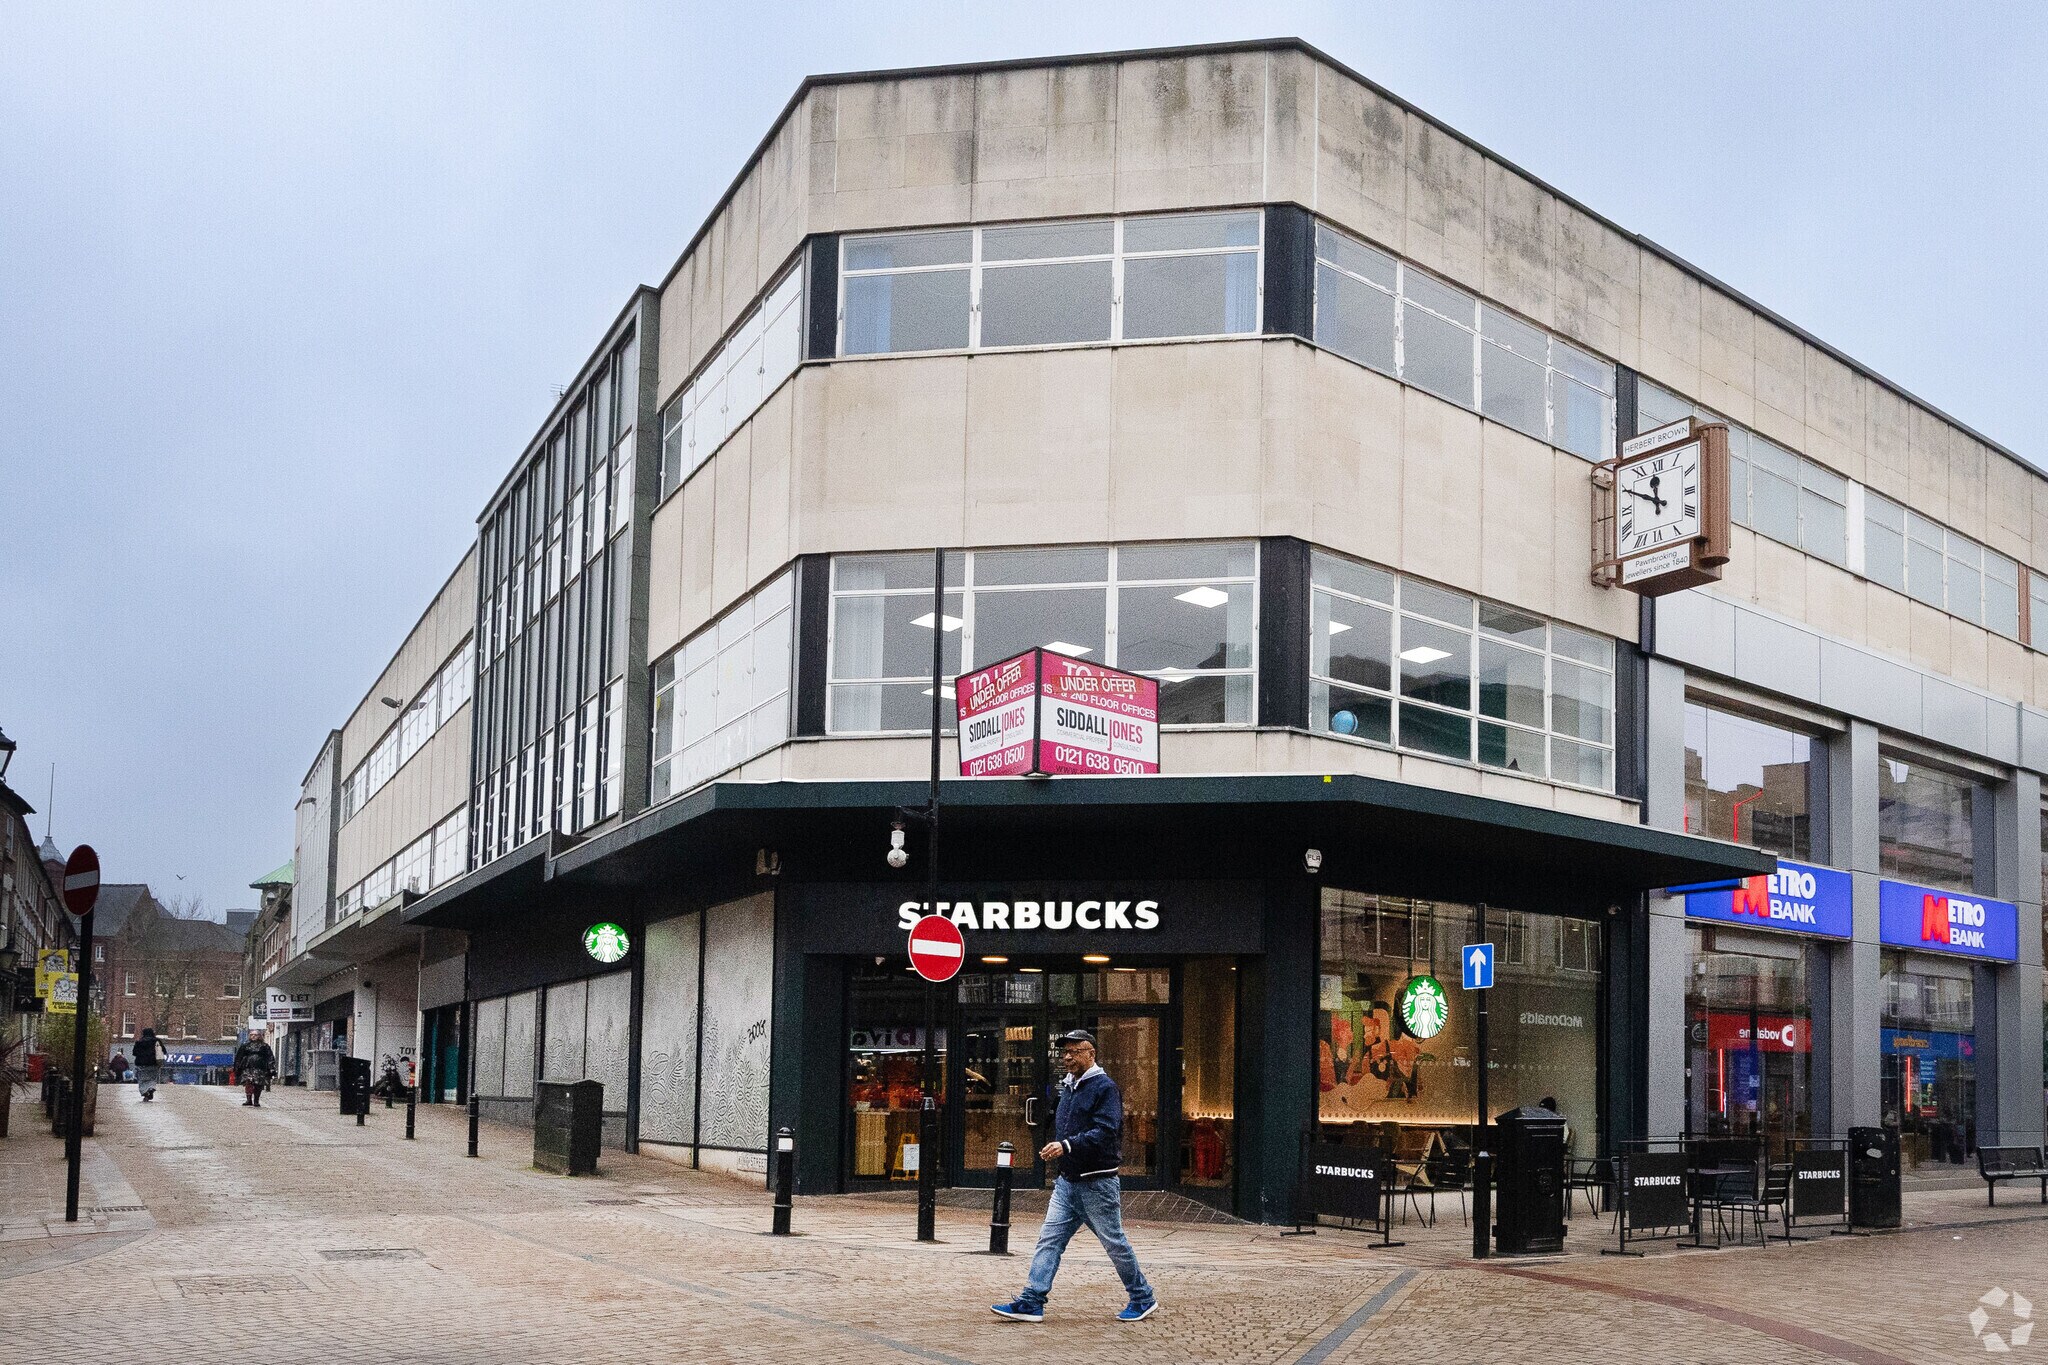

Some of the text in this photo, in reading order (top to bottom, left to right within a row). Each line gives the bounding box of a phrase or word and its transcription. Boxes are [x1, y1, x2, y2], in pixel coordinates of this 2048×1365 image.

[1625, 426, 1688, 453] HERBERT BROWN
[1636, 552, 1678, 567] Pawnbroking
[1654, 562, 1670, 571] since
[1672, 556, 1688, 566] 1840
[970, 683, 996, 710] UNDER
[997, 665, 1022, 692] OFFER
[1010, 682, 1035, 699] OFFICES
[1060, 676, 1099, 692] UNDER
[1101, 678, 1137, 693] OFFER
[1091, 695, 1119, 710] FLOOR
[1121, 702, 1156, 718] OFFICES
[968, 715, 1001, 743] SIDDALL
[1001, 706, 1025, 747] JONES
[1057, 707, 1143, 751] SIDDALL JONES
[970, 758, 986, 776] 0121
[987, 752, 1002, 771] 638
[1004, 745, 1025, 766] 0500
[1055, 746, 1082, 765] 0121
[1086, 752, 1110, 771] 638
[1113, 758, 1144, 774] 0500
[1732, 868, 1816, 917] METRO
[1769, 899, 1816, 924] BANK
[1921, 894, 1985, 943] METRO
[1949, 928, 1985, 949] BANK
[271, 994, 310, 1002] TO LET
[1315, 1164, 1374, 1179] STARBUCKS
[1634, 1175, 1681, 1187] STARBUCKS
[1798, 1170, 1840, 1180] STARBUCKS
